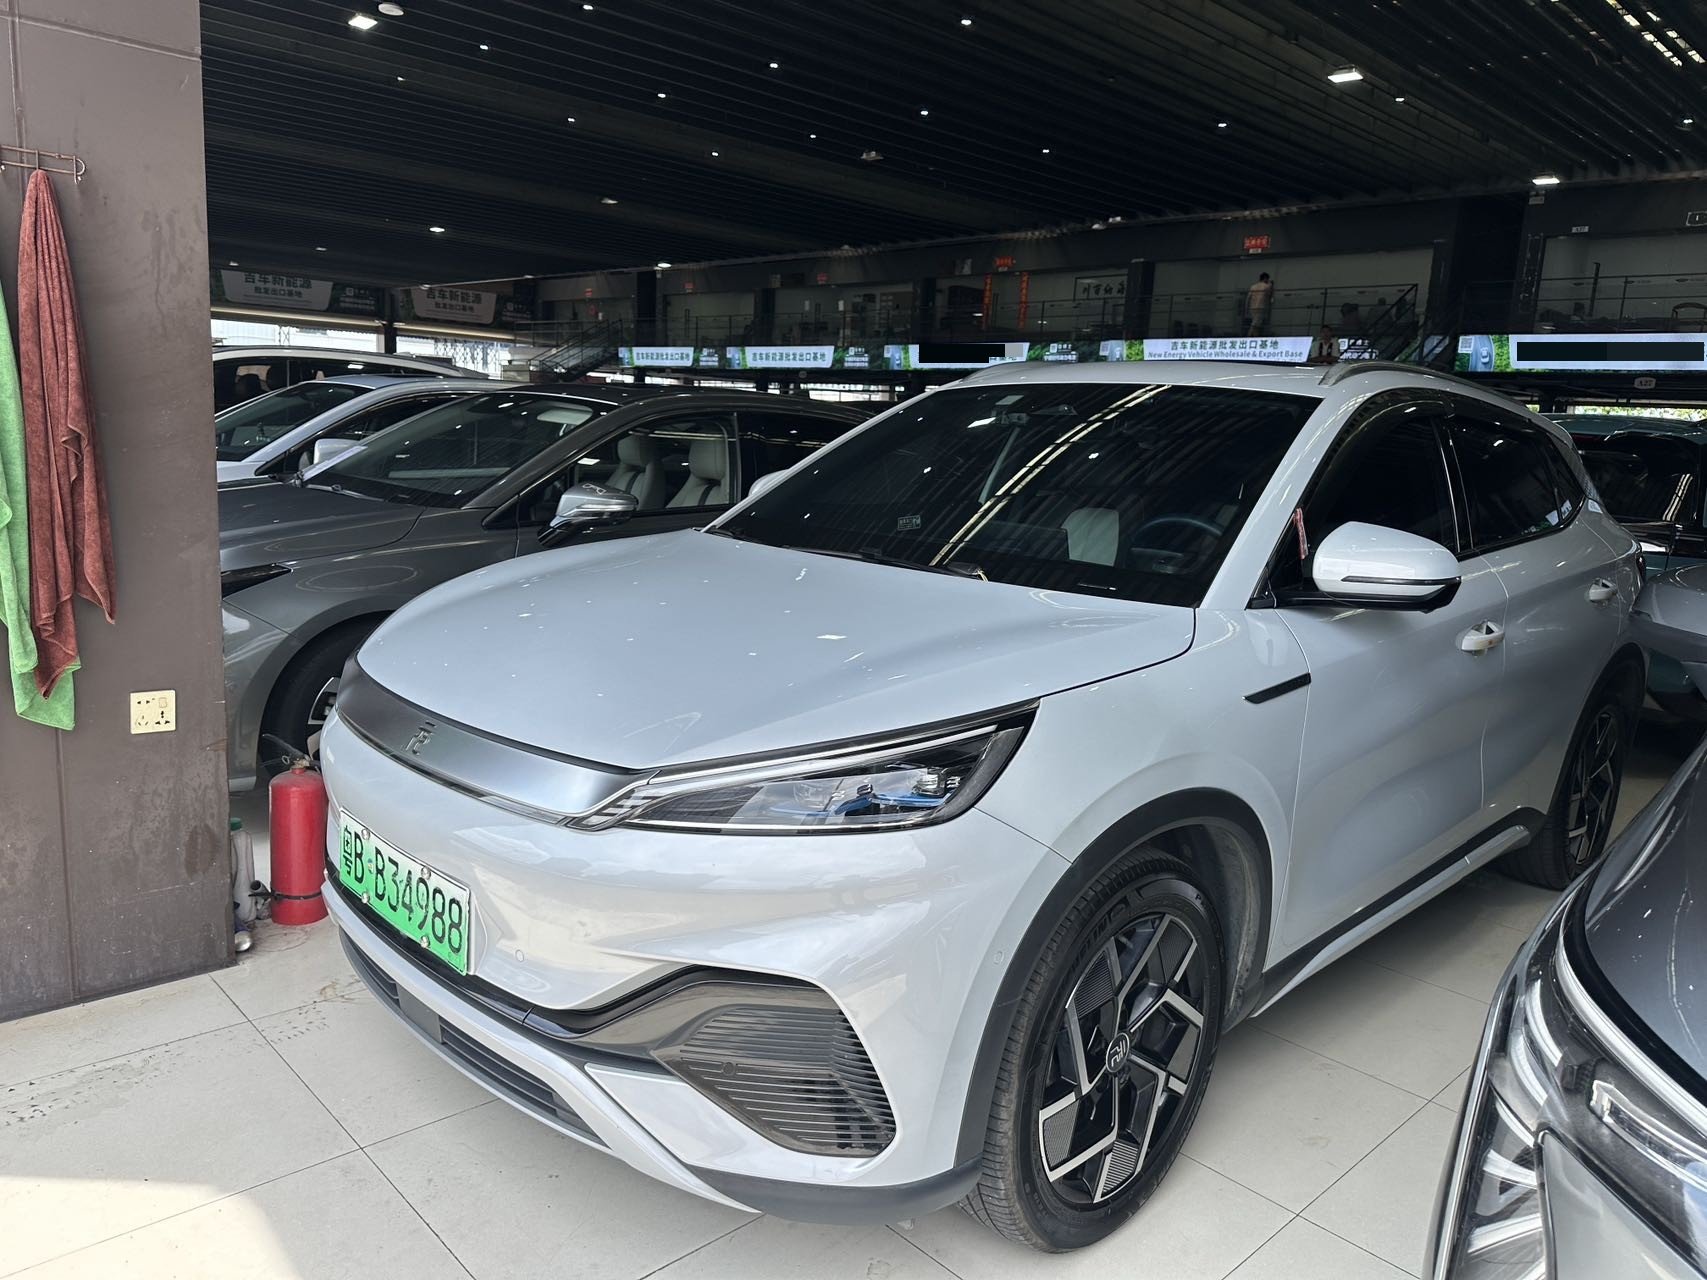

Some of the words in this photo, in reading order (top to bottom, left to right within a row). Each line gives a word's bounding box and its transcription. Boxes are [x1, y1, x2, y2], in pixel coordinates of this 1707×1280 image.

[1170, 339, 1278, 351] 吉车新能源批发出口基地
[1163, 351, 1188, 360] Energy
[1188, 350, 1213, 358] Vehicle
[1213, 350, 1251, 358] Wholesale
[1258, 351, 1284, 360] Export
